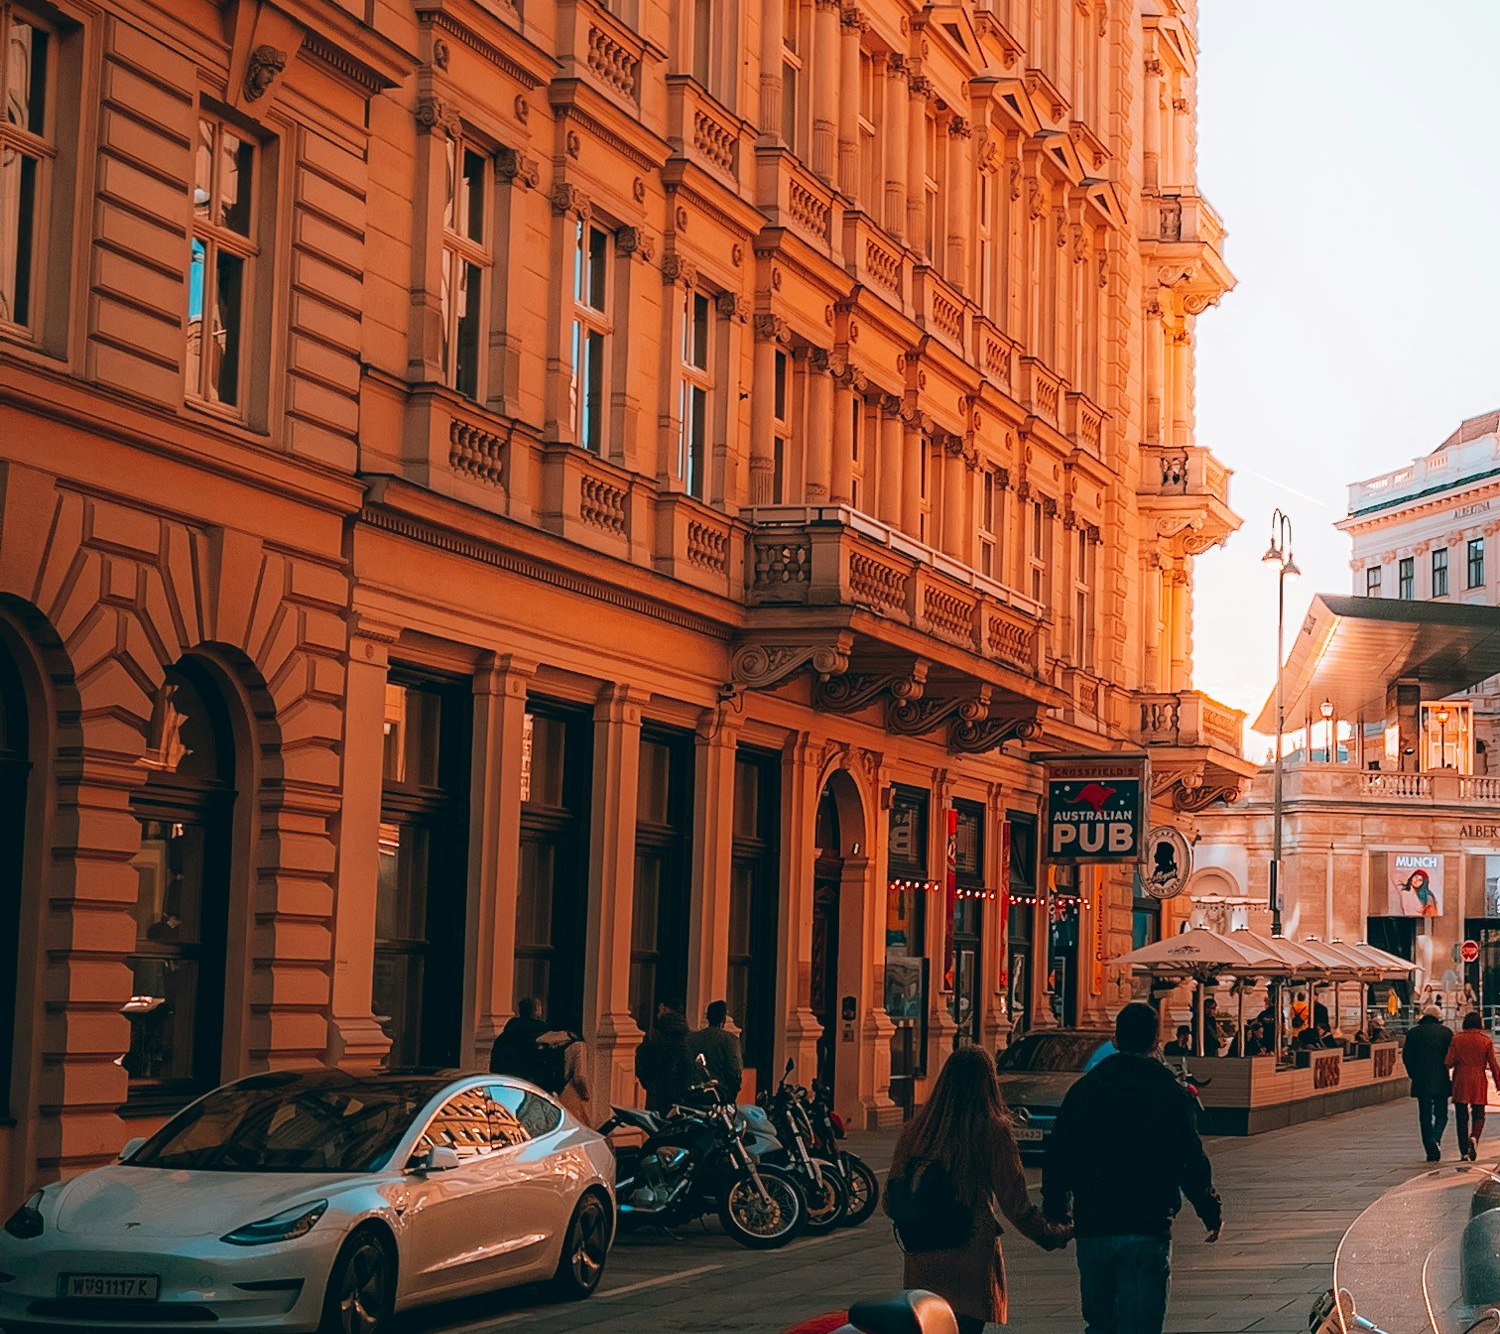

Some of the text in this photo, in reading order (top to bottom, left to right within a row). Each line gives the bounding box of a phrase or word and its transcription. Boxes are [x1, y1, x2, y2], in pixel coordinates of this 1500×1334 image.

[1053, 810, 1133, 822] AUSTRALIAN
[1052, 822, 1133, 853] PUB
[1395, 856, 1438, 868] MUNCH
[73, 1278, 84, 1295] W
